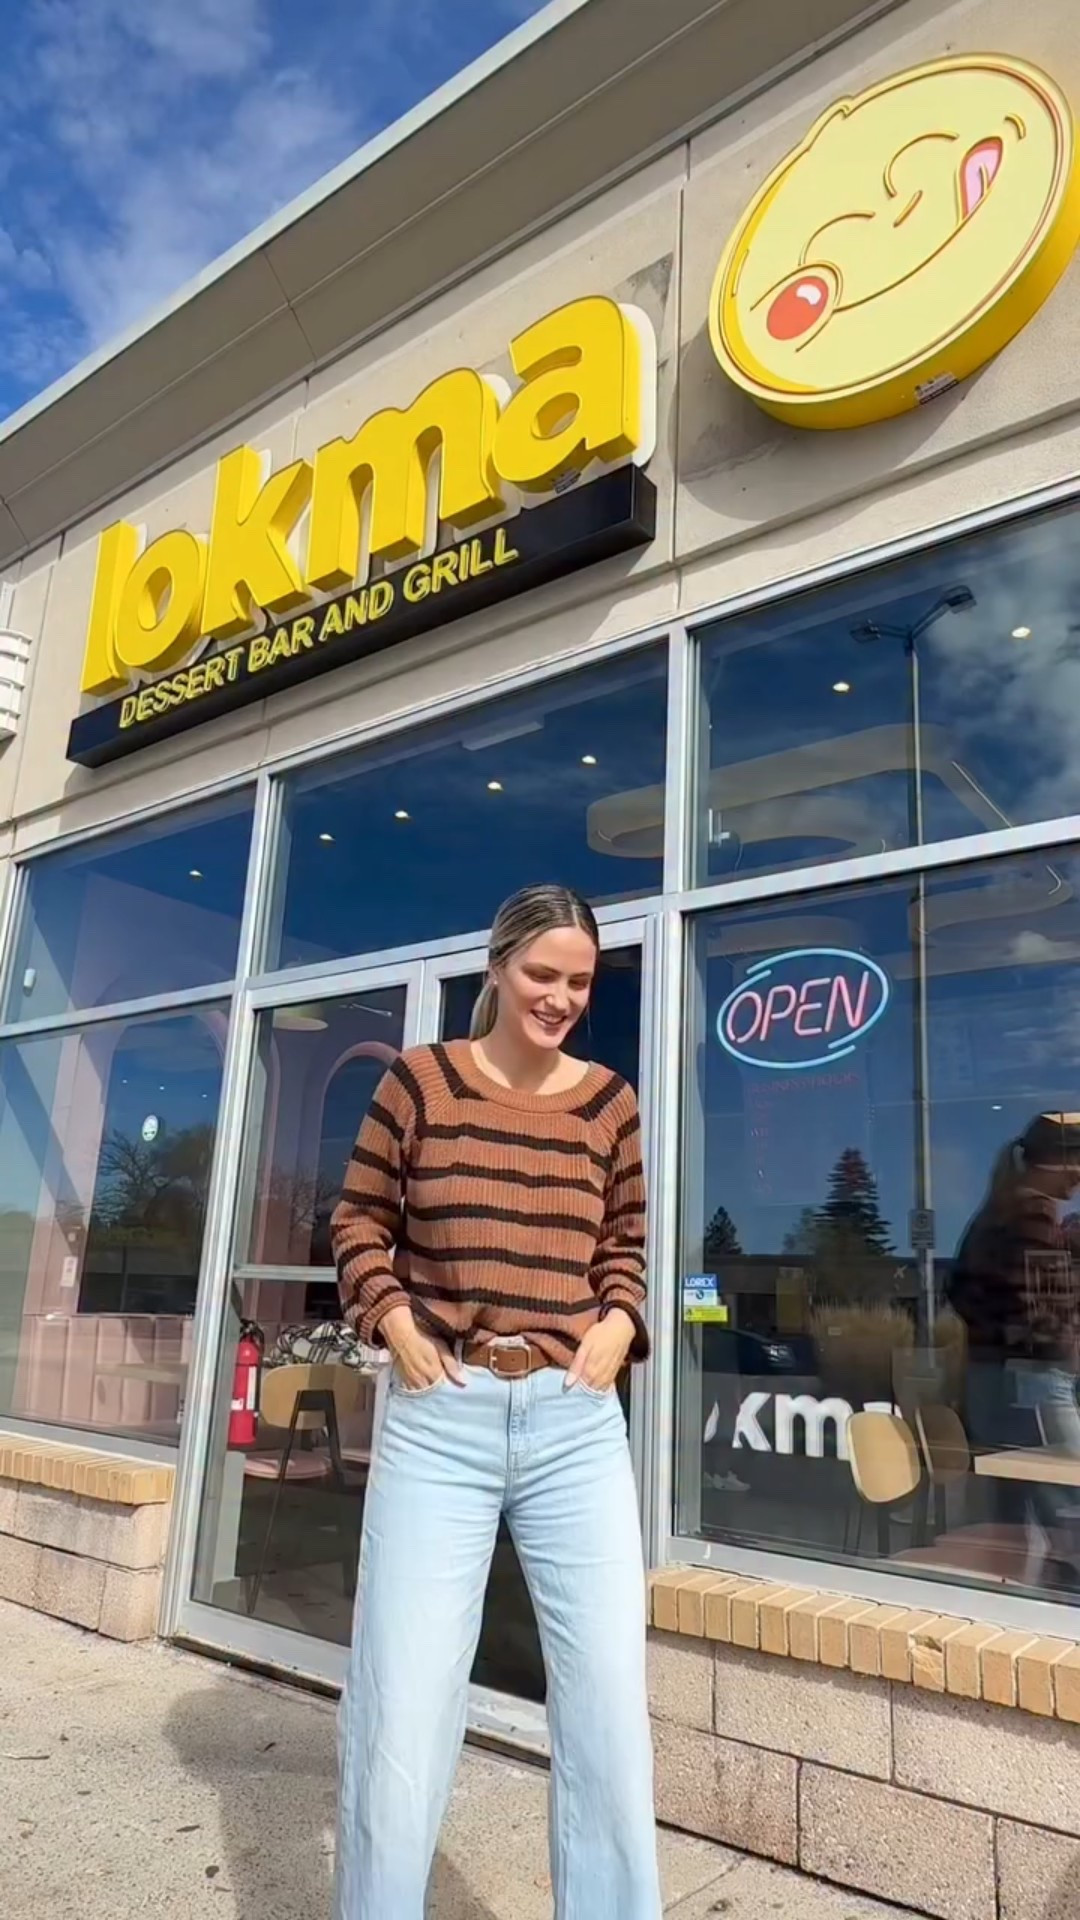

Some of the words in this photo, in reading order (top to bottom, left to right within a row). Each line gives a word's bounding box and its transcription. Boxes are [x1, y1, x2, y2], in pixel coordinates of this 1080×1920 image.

[81, 295, 641, 697] lokma
[119, 647, 245, 729] DESSERT
[247, 615, 315, 672] BAR
[318, 581, 395, 641] AND
[403, 527, 519, 602] GRILL
[726, 970, 870, 1043] OPEN
